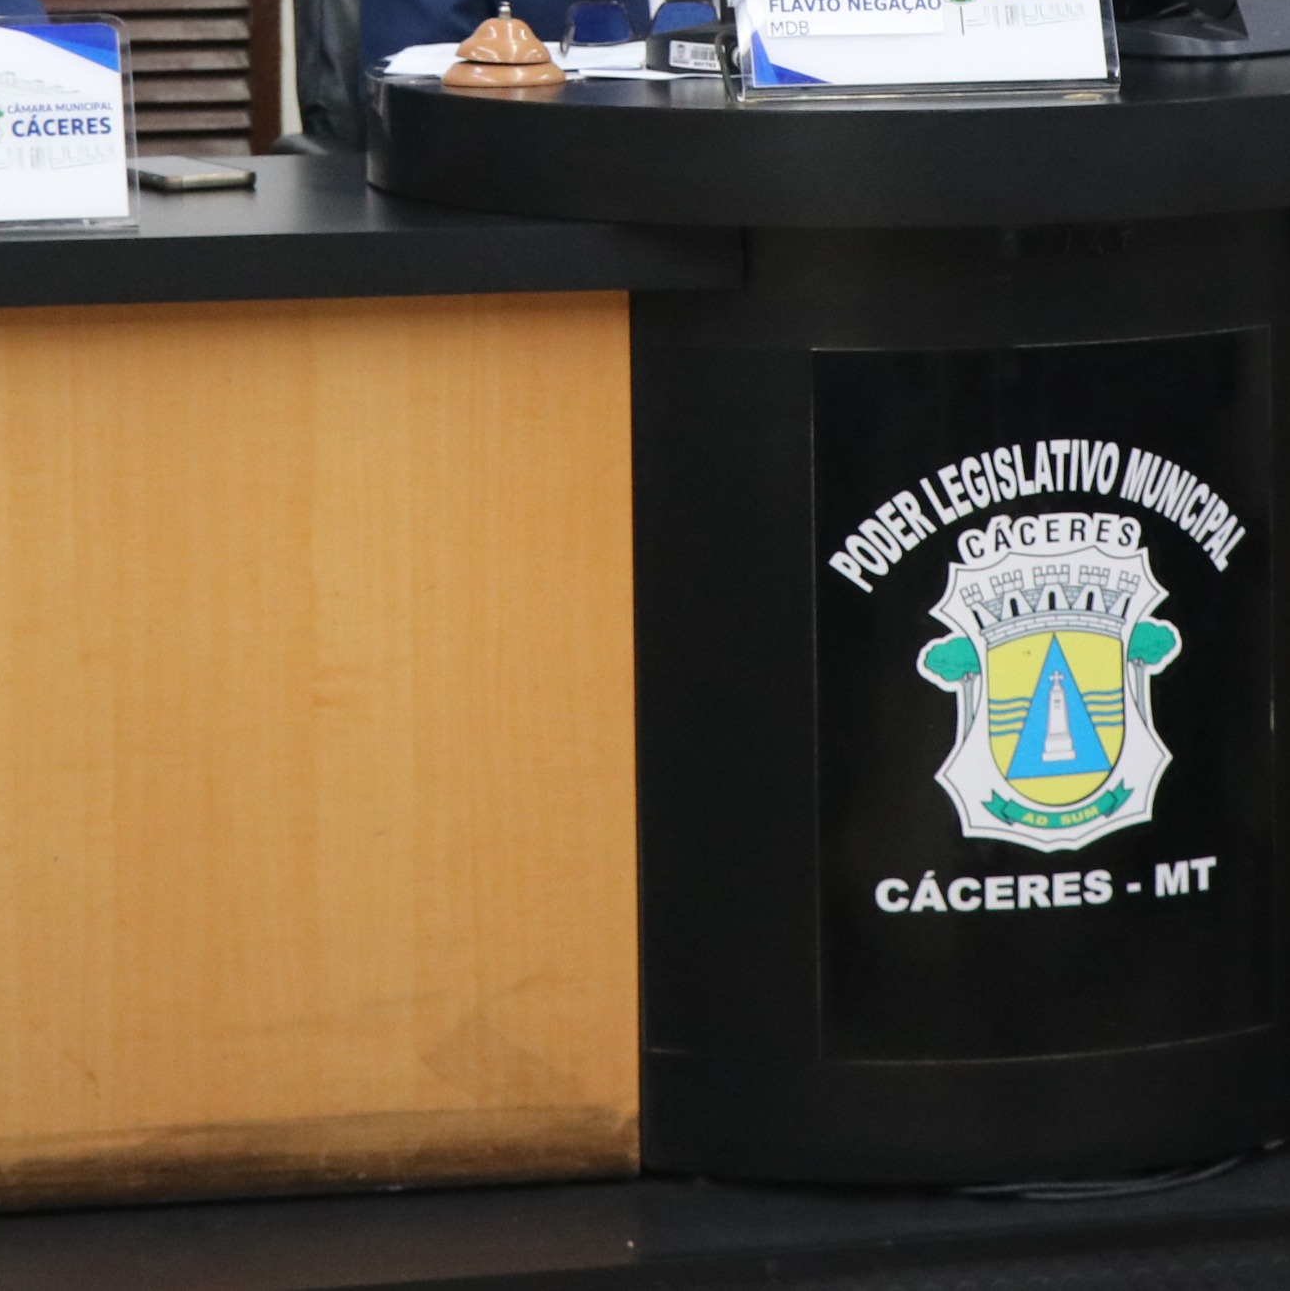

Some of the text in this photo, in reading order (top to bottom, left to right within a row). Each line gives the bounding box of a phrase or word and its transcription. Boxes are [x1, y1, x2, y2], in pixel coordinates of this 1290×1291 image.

[770, 20, 811, 36] MDB
[7, 102, 114, 114] CÂMARA MUNICIPAL
[11, 114, 113, 138] CÁCERES
[828, 438, 1247, 594] PODER LEGISLATIVO MUNICIPAL
[964, 515, 1137, 560] CÁCERES
[1021, 805, 1100, 826] AD SUM
[875, 870, 1114, 912] CÁCERES
[1155, 857, 1218, 898] MT
